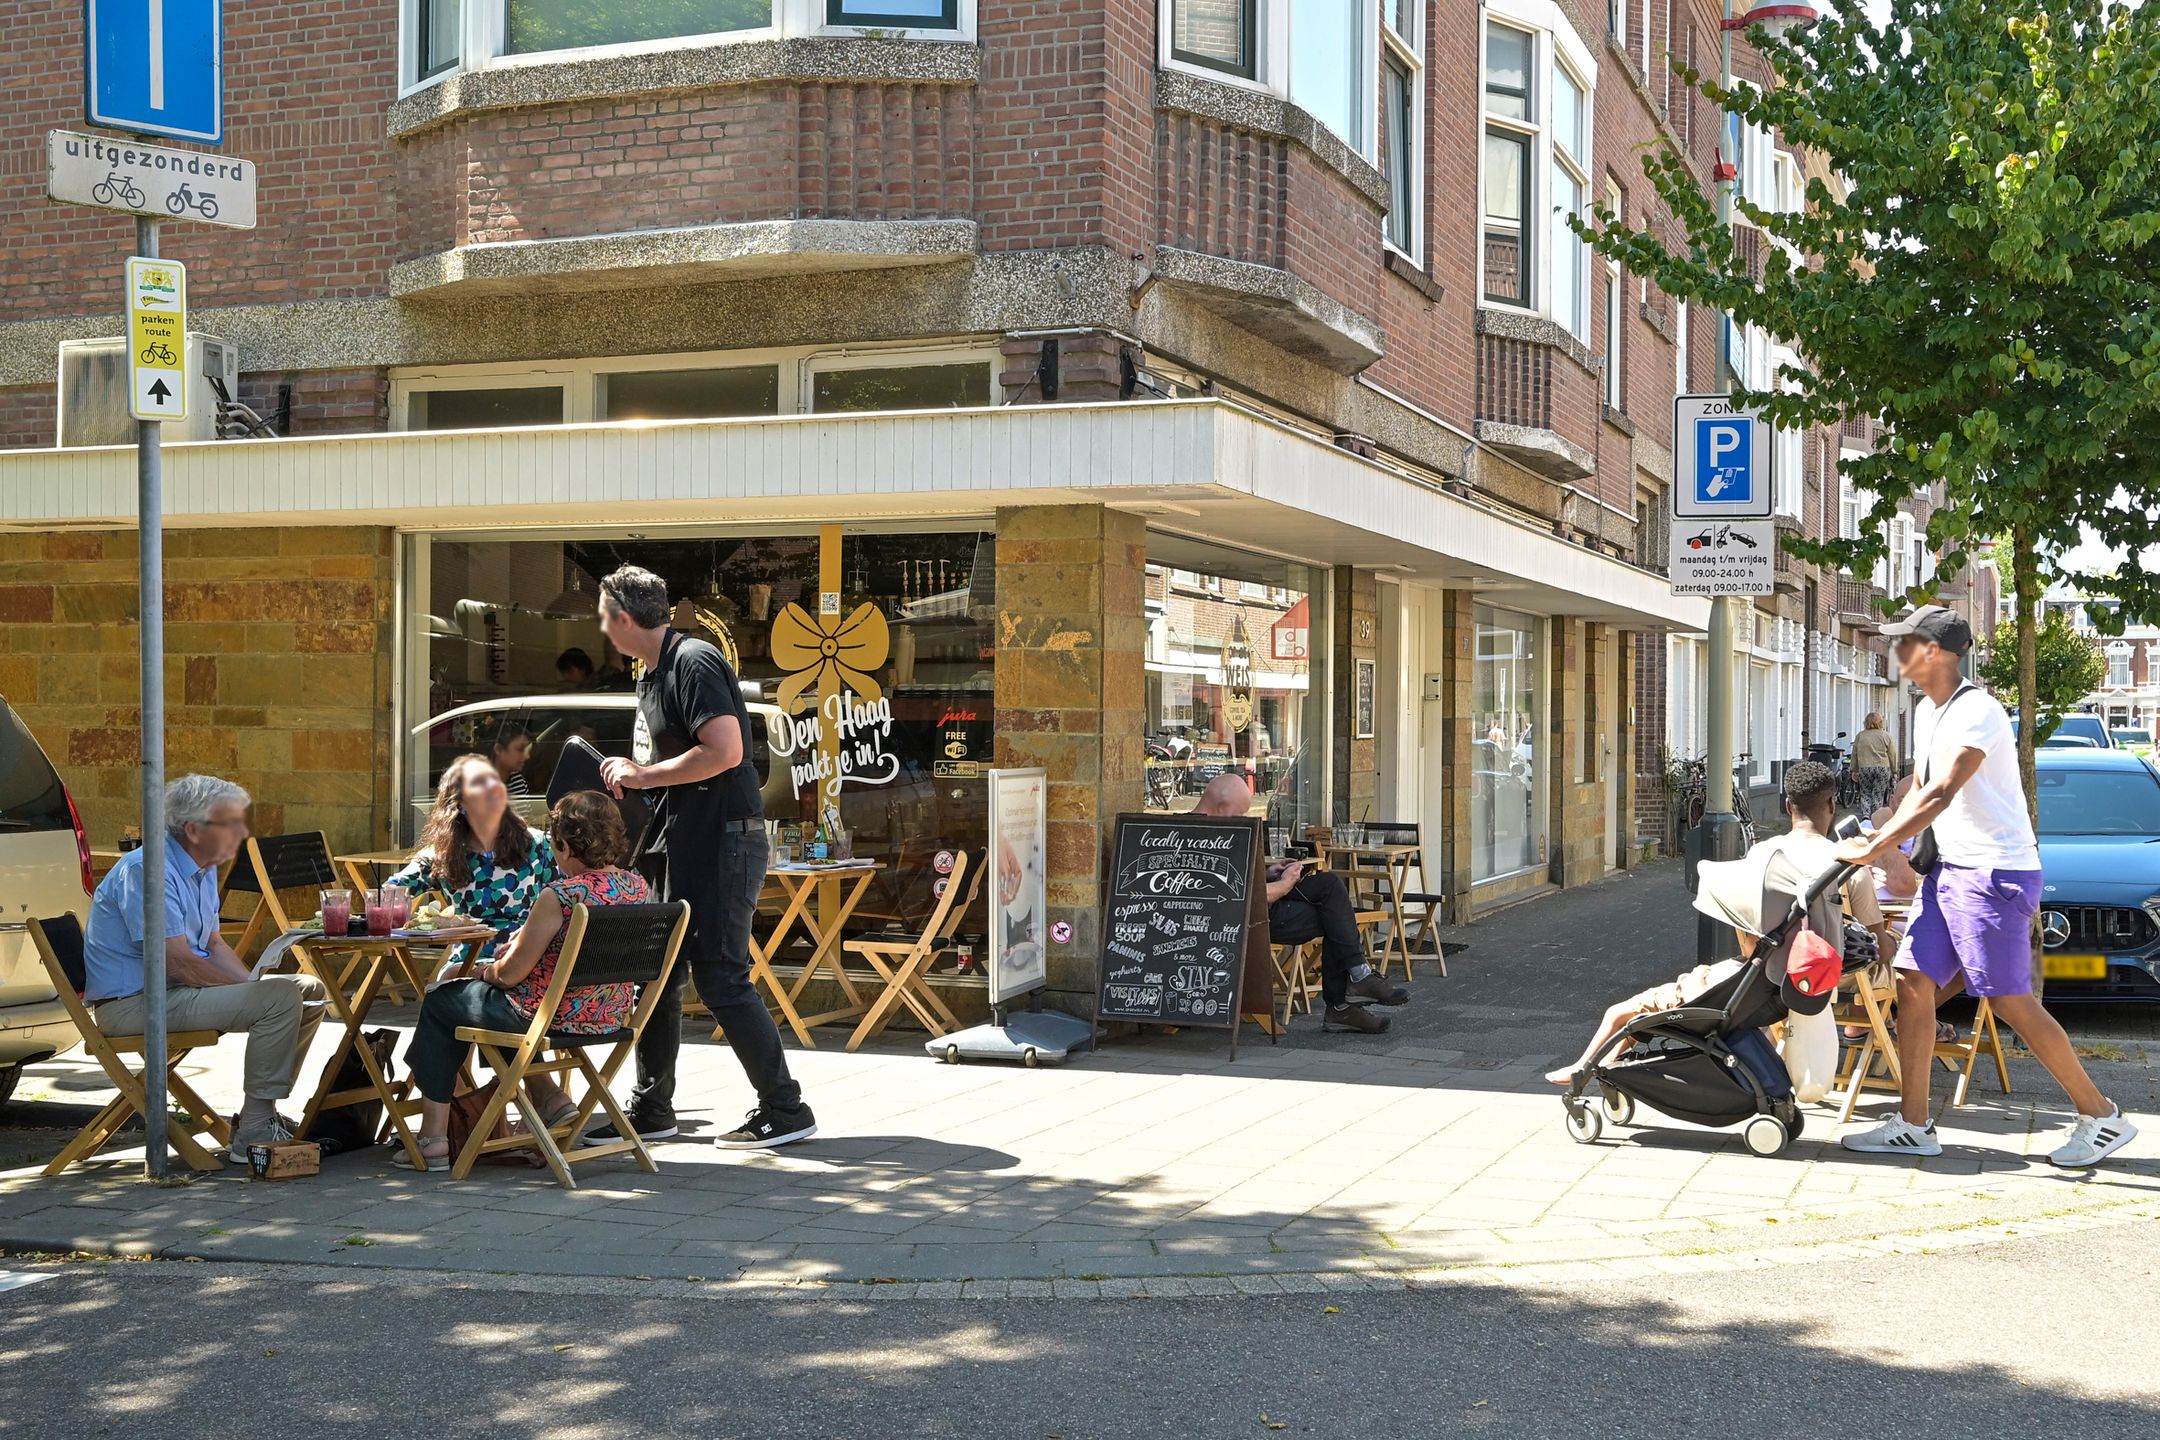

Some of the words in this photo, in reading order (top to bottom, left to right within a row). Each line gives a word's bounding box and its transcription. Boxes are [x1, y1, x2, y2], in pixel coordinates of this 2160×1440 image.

[65, 139, 243, 182] uitgezonderd
[141, 315, 175, 325] parken
[145, 328, 171, 337] route
[1702, 403, 1745, 415] ZON
[1709, 426, 1741, 468] P
[1679, 555, 1716, 565] maandag
[1719, 555, 1736, 564] t/m
[1738, 555, 1768, 566] vrijdag
[1692, 569, 1745, 578] 09.00-24.00
[1748, 569, 1754, 578] h
[1674, 584, 1711, 593] zaterdag
[1713, 583, 1762, 593] 09.00-17.00
[1765, 583, 1771, 592] h
[1360, 619, 1370, 640] 39
[1225, 664, 1251, 688] WEIS
[767, 711, 823, 757] Den
[823, 690, 895, 740] Haag
[936, 705, 977, 728] jura
[945, 731, 967, 740] FREE
[791, 749, 833, 801] pakt
[855, 728, 881, 766] in!
[949, 768, 977, 776] Facebook
[1140, 829, 1184, 860] locally
[1186, 834, 1234, 850] roasted
[1148, 853, 1219, 871] SPECIALTY
[1149, 871, 1215, 895] Coffee
[1114, 901, 1158, 921] espresso
[1162, 901, 1204, 910] CAPPUCCINO
[1115, 922, 1147, 933] FRESH
[1183, 924, 1209, 932] SHAKES
[1223, 923, 1241, 933] iced
[1115, 932, 1146, 943] SOUP
[1209, 931, 1238, 943] COFFEE
[1106, 940, 1147, 963] PANINIS
[1152, 935, 1198, 956] SANDWICHES
[1205, 946, 1226, 963] tea
[1109, 965, 1143, 980] yoghurts
[1177, 965, 1213, 989] STAY
[1110, 986, 1139, 999] VISIT
[1141, 987, 1158, 999] US
[1124, 990, 1160, 1007] online!
[1666, 1013, 1684, 1021] YOYO
